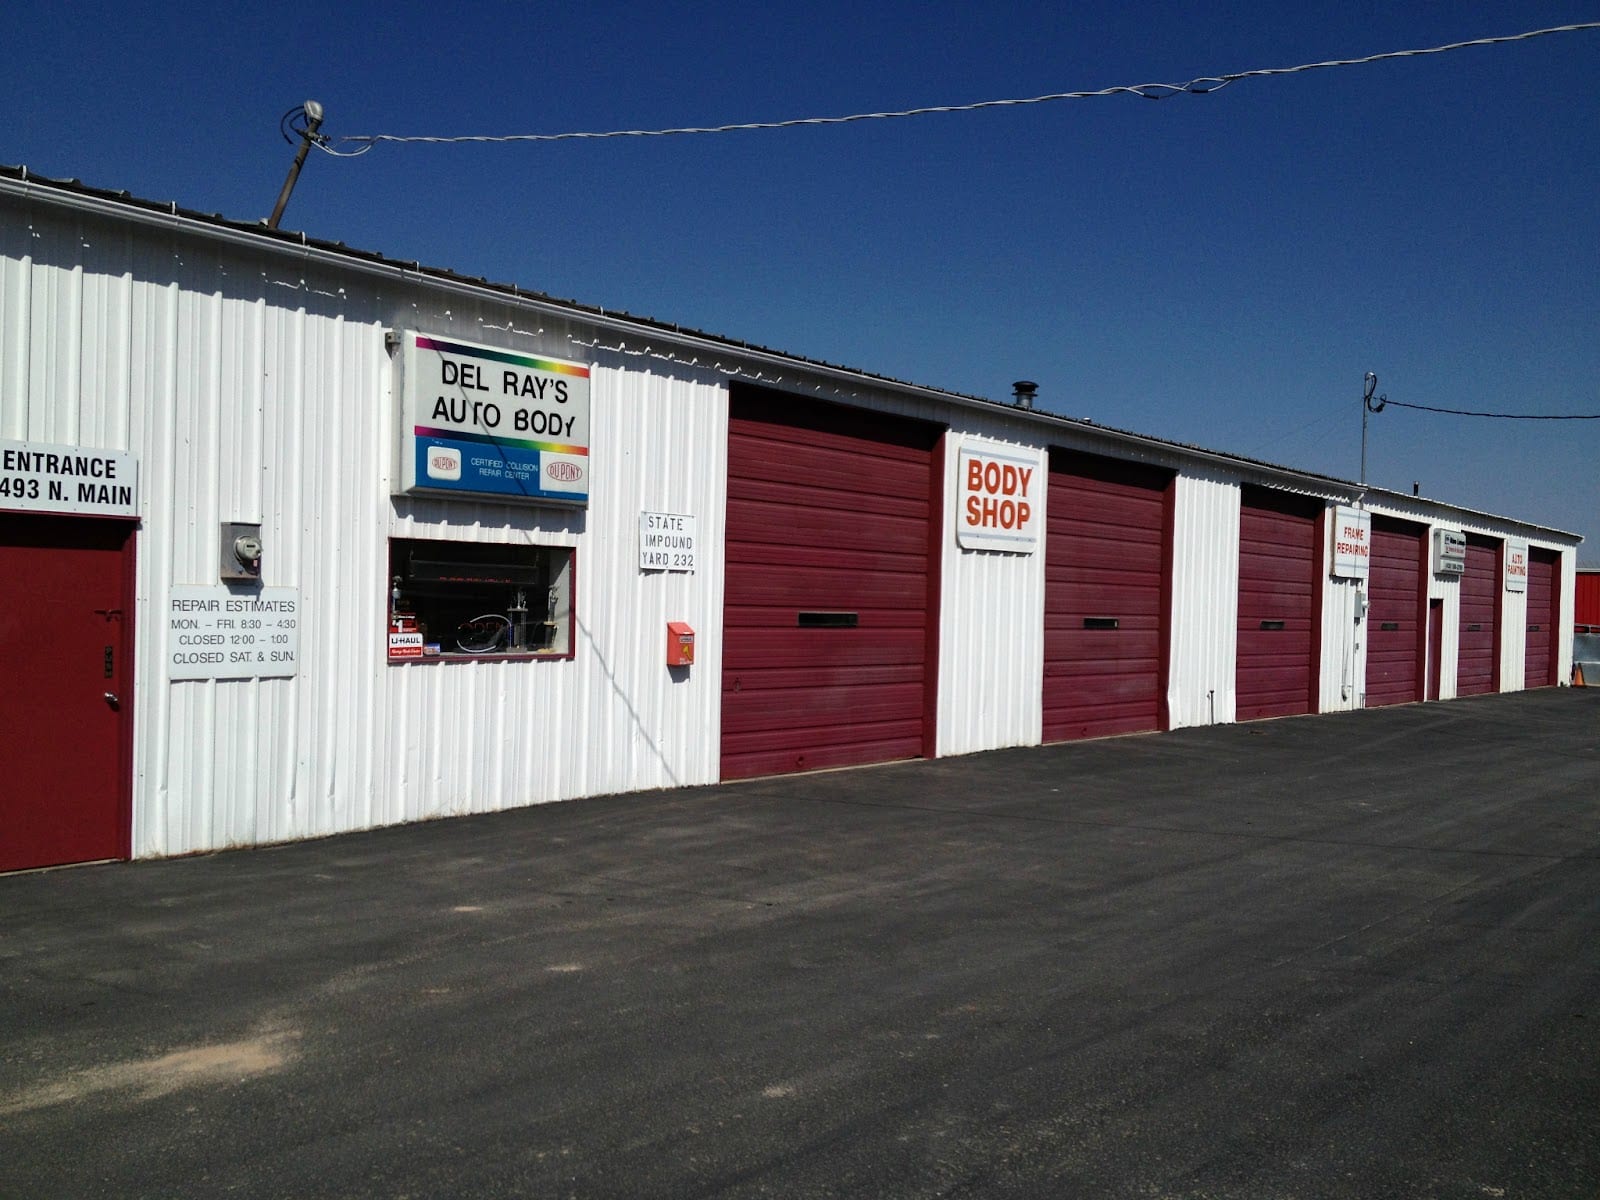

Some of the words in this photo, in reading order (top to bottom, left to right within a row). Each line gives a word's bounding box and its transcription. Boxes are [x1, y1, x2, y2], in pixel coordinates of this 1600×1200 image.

[441, 359, 490, 392] DEL
[503, 370, 568, 404] RAY'S
[431, 396, 500, 428] AUTO
[514, 408, 576, 437] BODY
[3, 449, 116, 479] ENTRANCE
[470, 457, 503, 468] CERTIFIED
[506, 461, 539, 472] COLLISION
[479, 467, 501, 477] REPAIR
[504, 470, 530, 481] CENTER
[967, 458, 1033, 497] BODY
[0, 477, 40, 499] 493
[48, 480, 69, 501] N.
[78, 483, 131, 506] MAIN
[966, 495, 1031, 530] SHOP
[648, 516, 683, 531] STATE
[1344, 526, 1364, 541] FRAME
[645, 534, 693, 550] IMPOUND
[1337, 542, 1368, 557] REPAIRING
[642, 552, 669, 565] YARD
[674, 554, 694, 567] 232
[172, 599, 220, 612] REPAIR
[226, 600, 295, 612] ESTIMATES
[171, 619, 199, 629] MON.
[240, 619, 261, 629] 8:30
[277, 619, 296, 629] 4:30
[178, 634, 225, 645] CLOSED
[230, 634, 255, 645] 12:00
[271, 634, 288, 644] 1:00
[173, 652, 225, 664] CLOSED
[257, 651, 265, 662] &
[270, 651, 295, 662] SUN.
